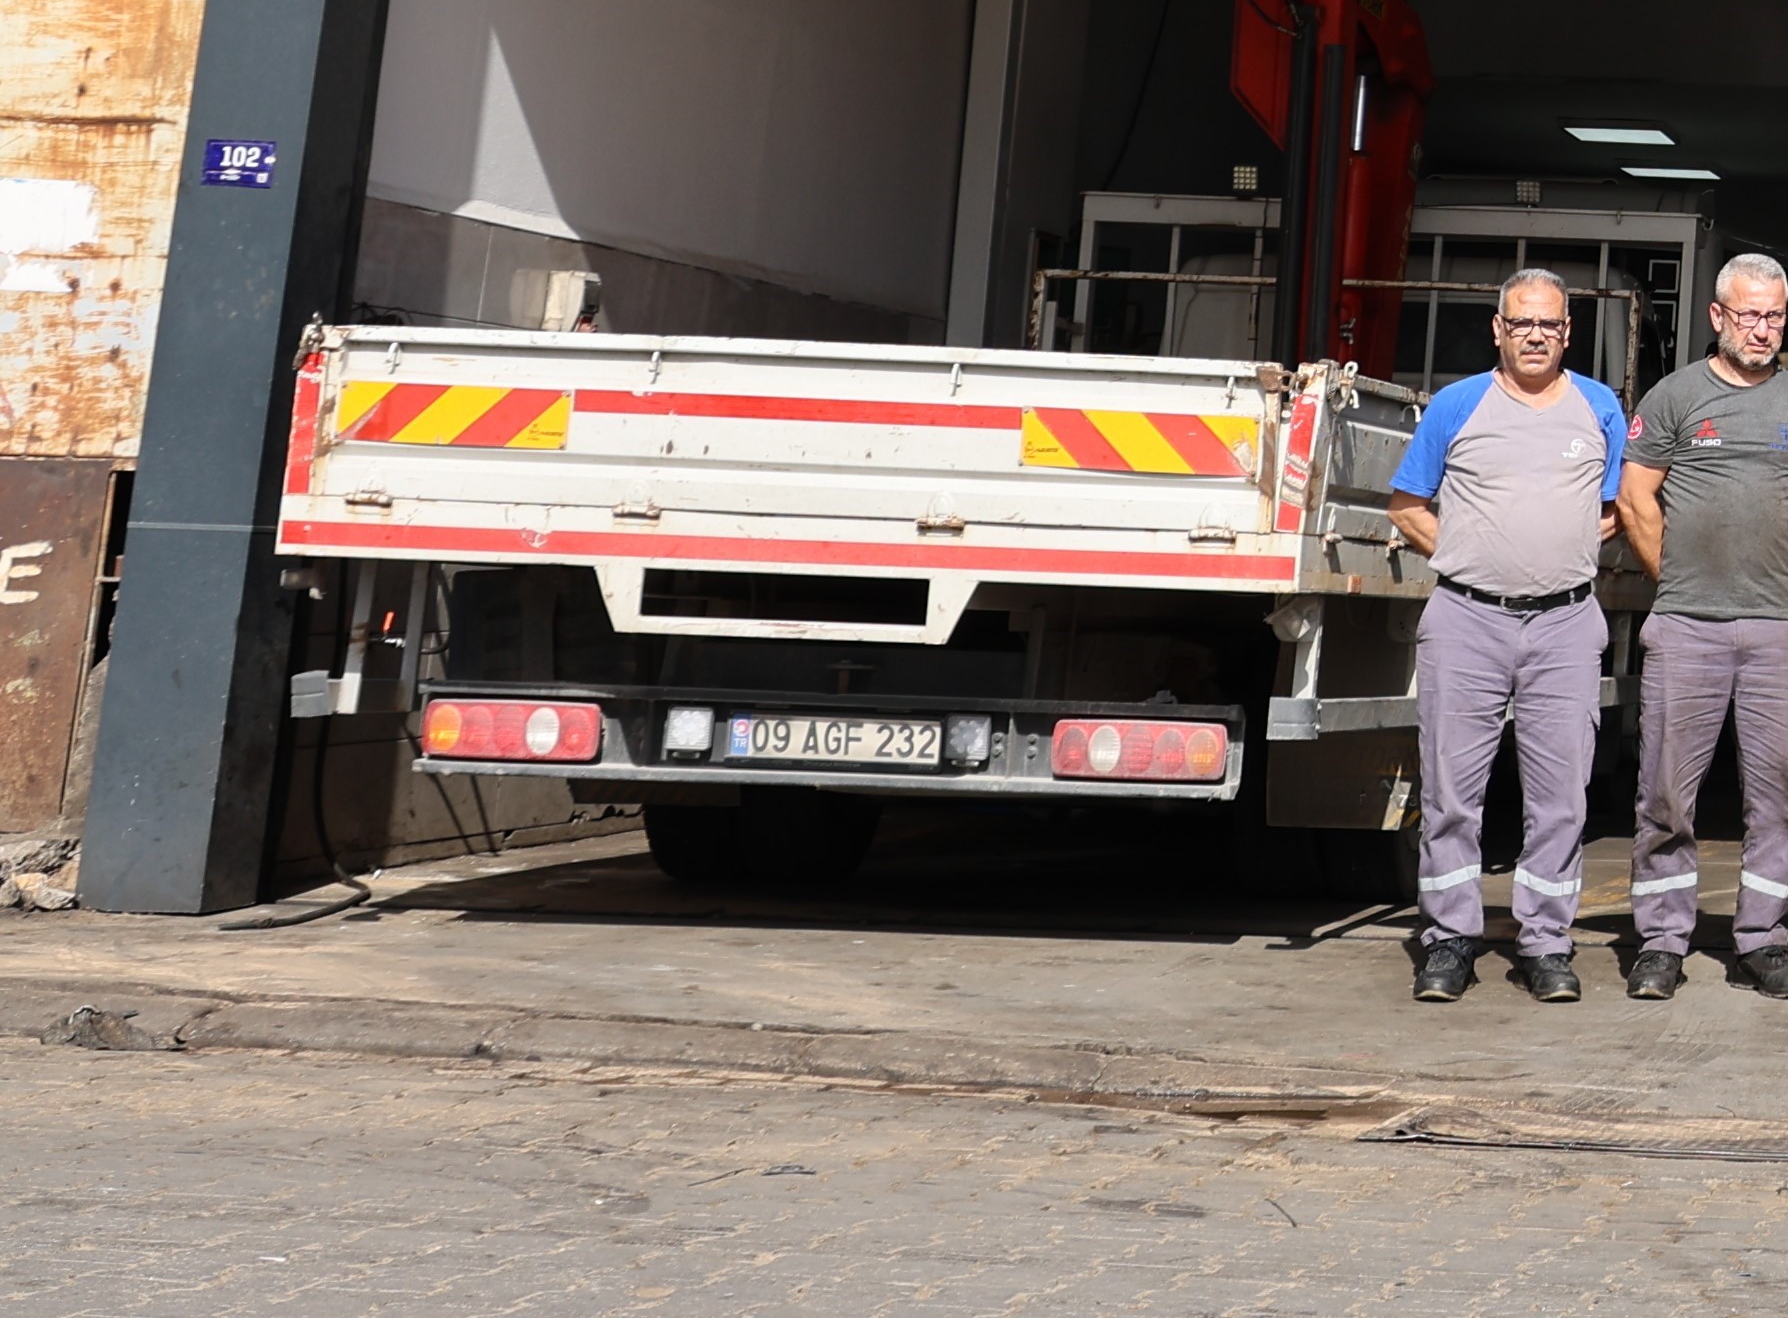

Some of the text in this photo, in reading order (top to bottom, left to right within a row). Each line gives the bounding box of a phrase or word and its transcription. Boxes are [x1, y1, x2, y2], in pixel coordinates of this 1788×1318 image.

[220, 145, 262, 168] 102
[1691, 438, 1722, 447] FUSO
[751, 718, 937, 759] 09 AGF 232
